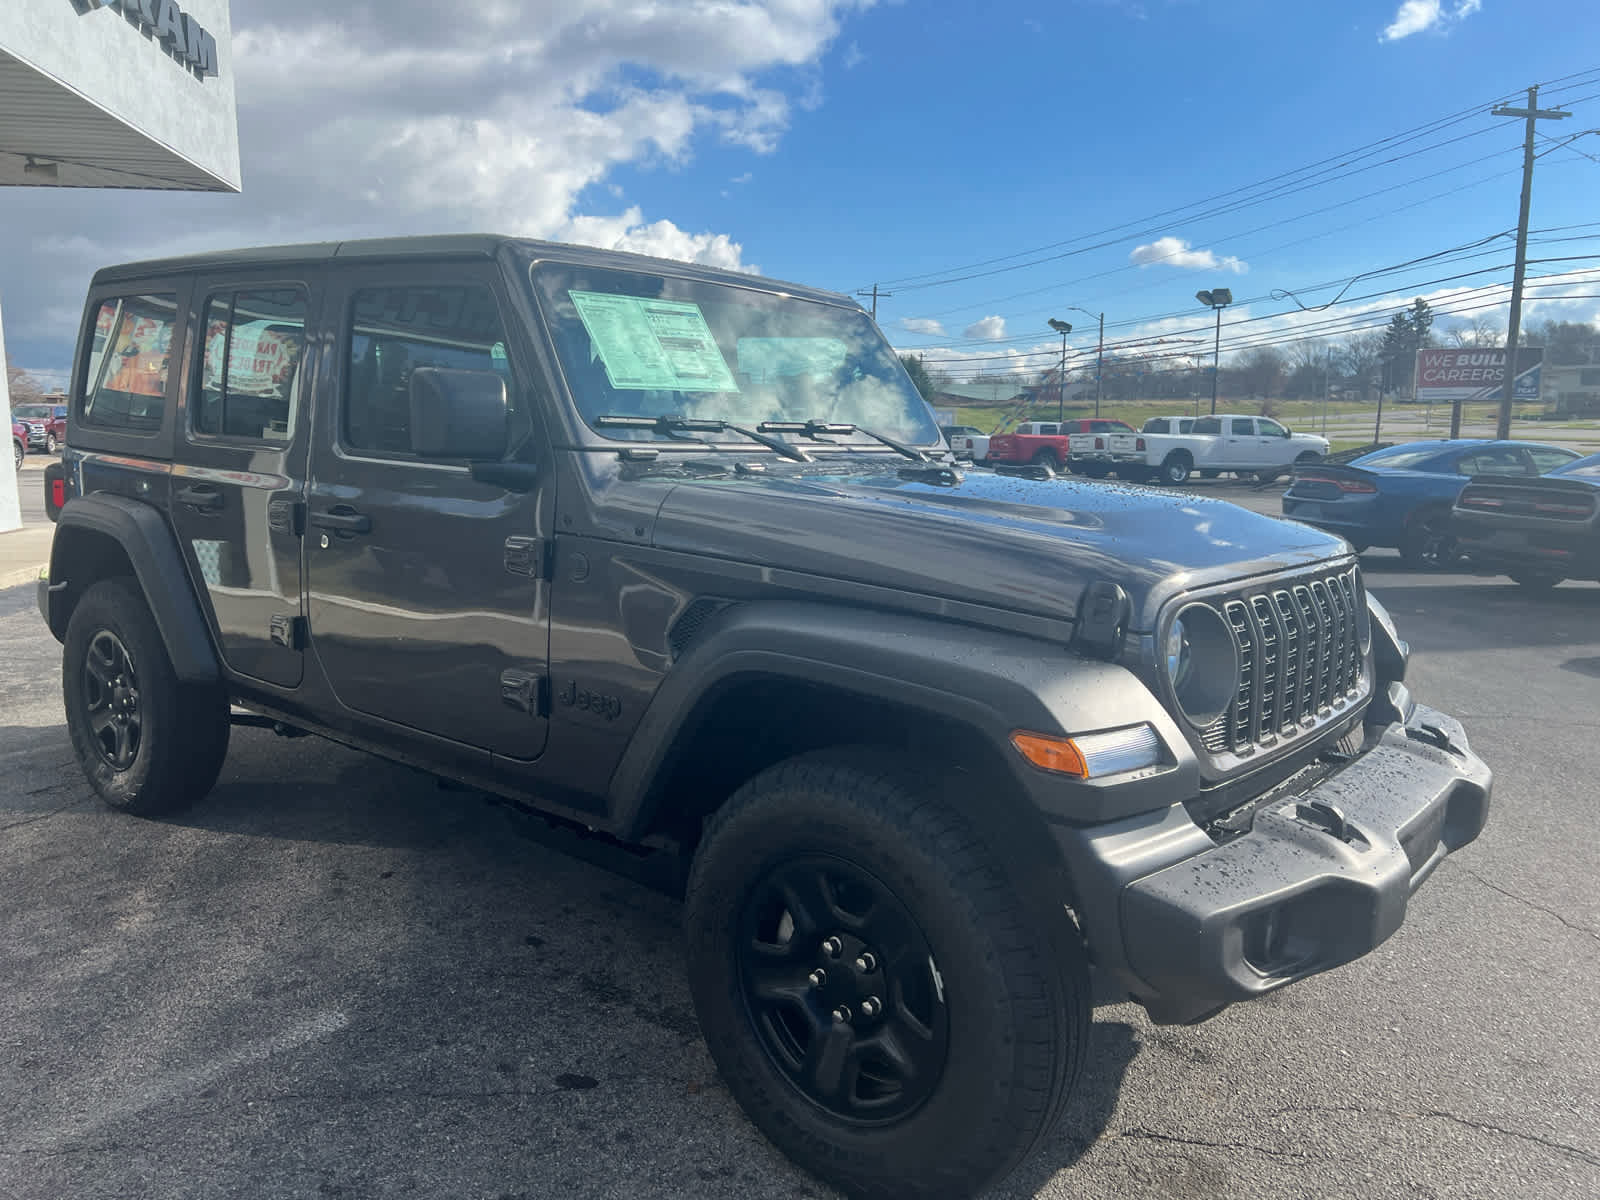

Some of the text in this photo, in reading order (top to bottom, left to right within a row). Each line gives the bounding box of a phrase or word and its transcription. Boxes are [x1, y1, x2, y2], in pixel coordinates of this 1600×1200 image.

[1425, 353, 1506, 367] WE BUIL
[1423, 368, 1504, 381] CAREERS
[559, 680, 624, 721] Jeep
